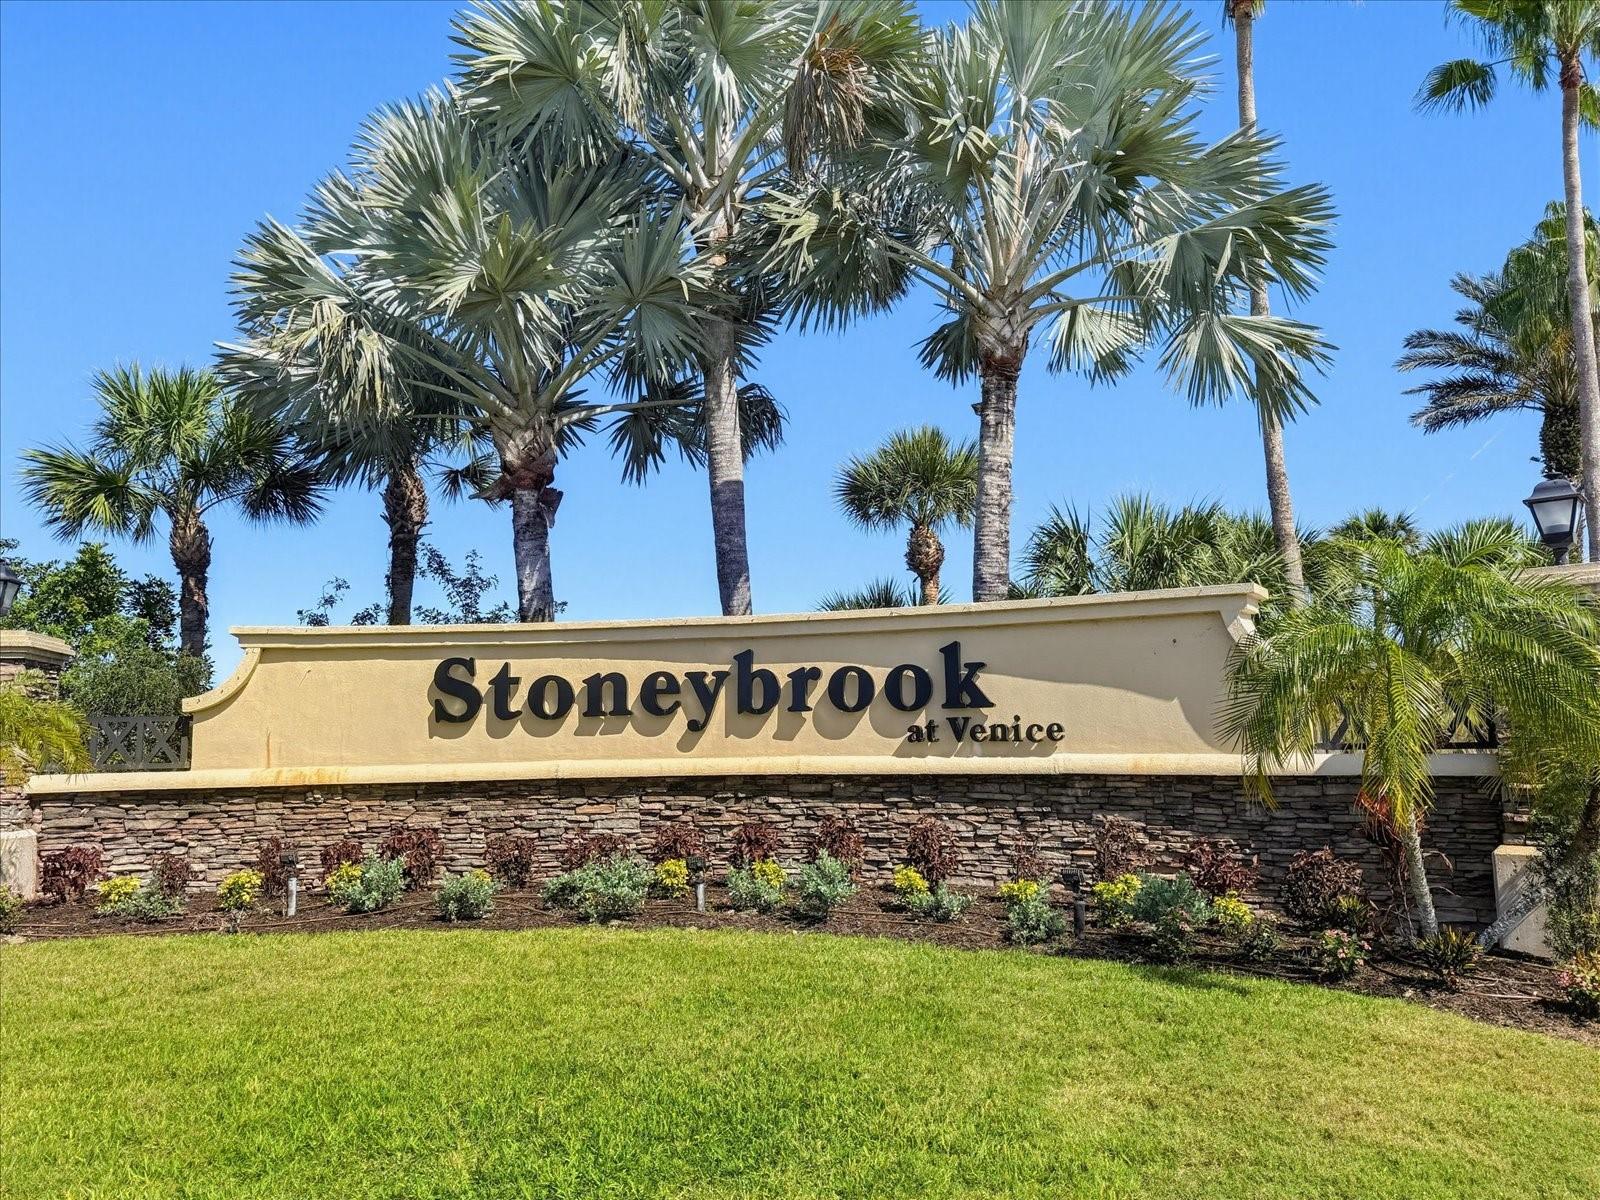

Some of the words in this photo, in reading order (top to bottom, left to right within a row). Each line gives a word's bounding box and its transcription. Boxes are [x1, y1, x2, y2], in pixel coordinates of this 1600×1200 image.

[433, 641, 995, 732] Stoneybrook
[907, 719, 939, 743] at
[946, 714, 1065, 743] Venice
